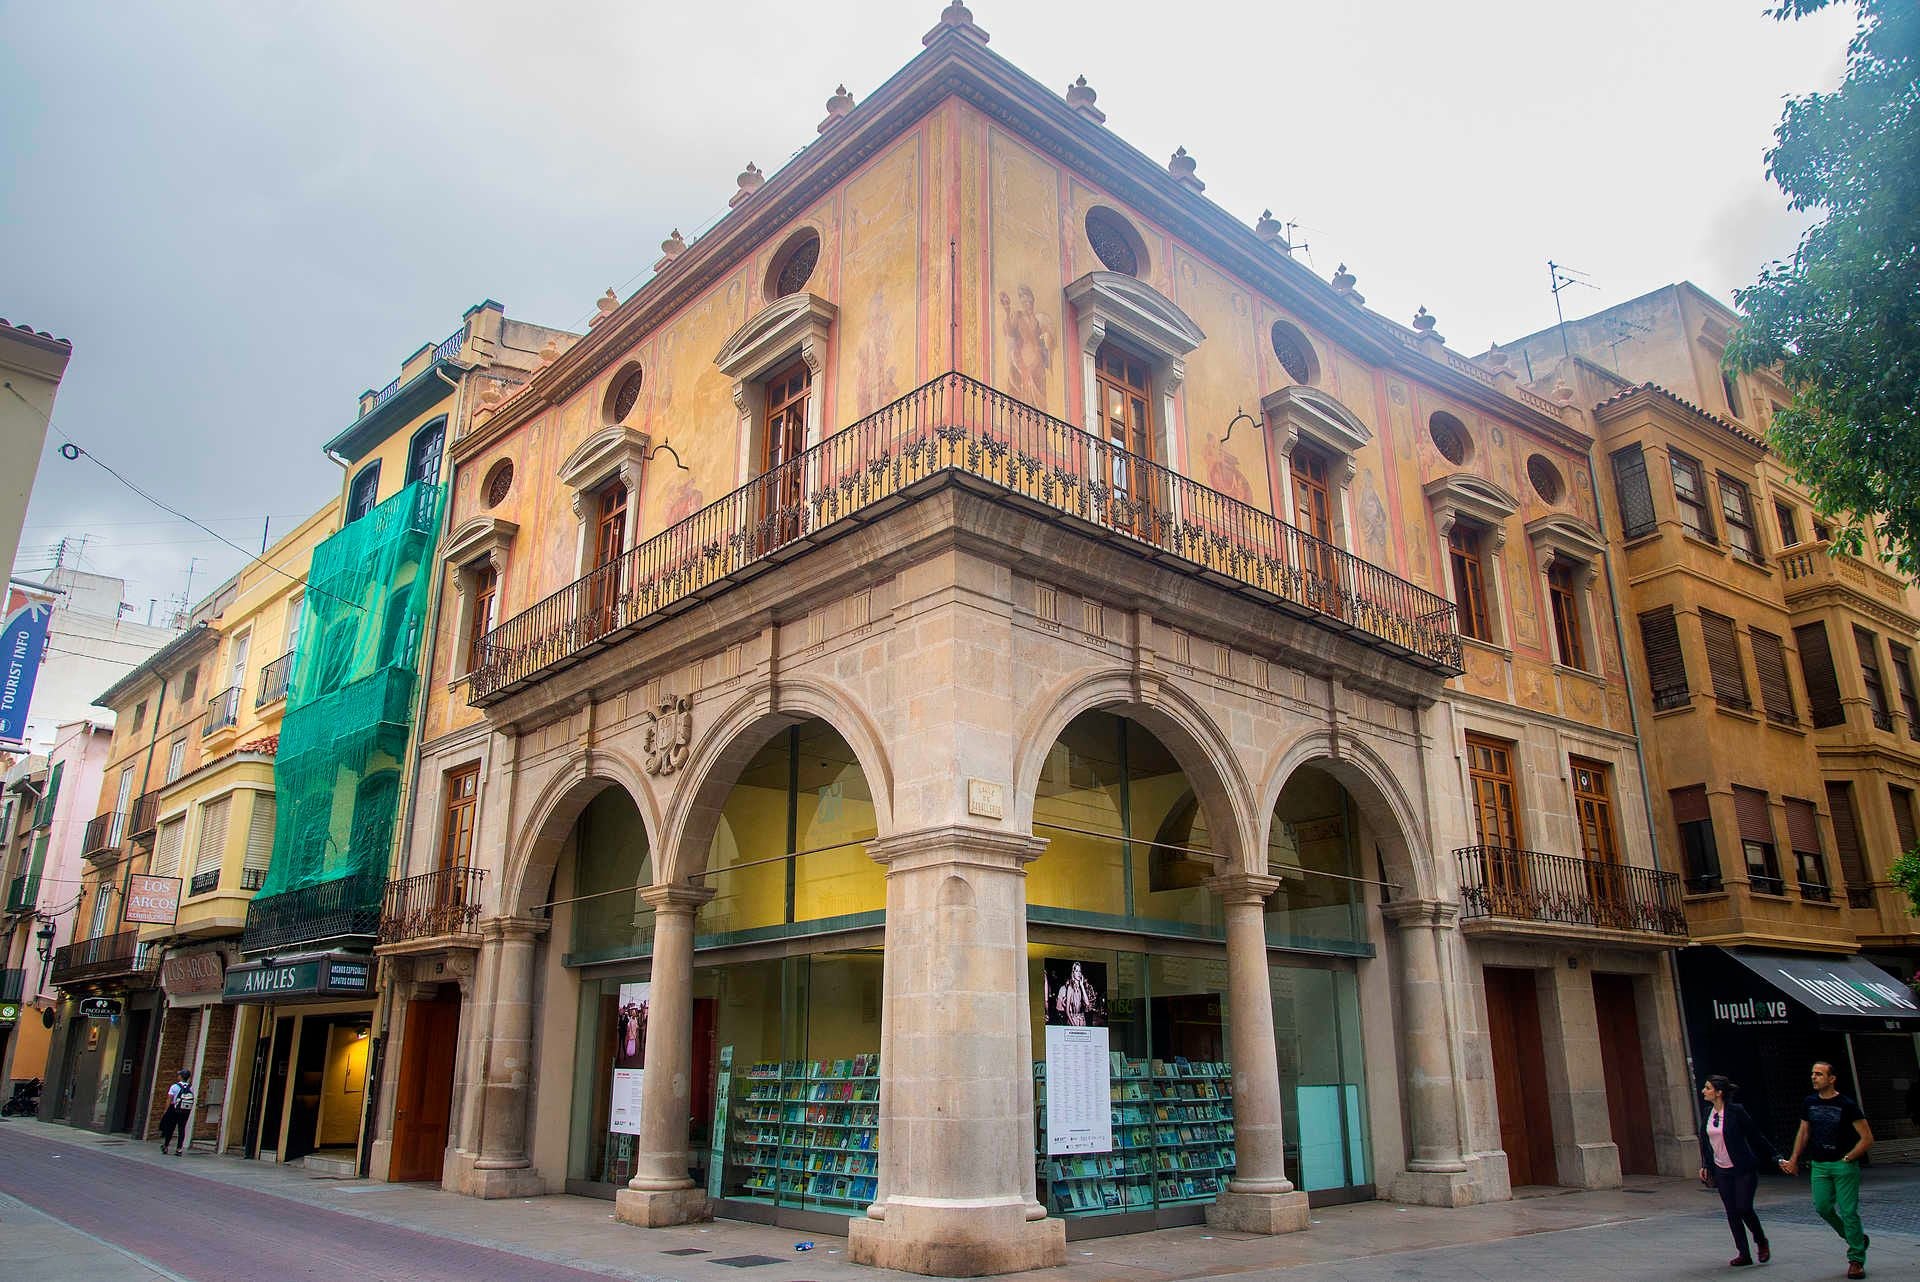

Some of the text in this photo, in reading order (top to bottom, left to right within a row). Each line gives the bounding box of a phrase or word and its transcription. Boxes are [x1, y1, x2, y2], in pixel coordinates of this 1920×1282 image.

[1, 631, 30, 710] TOURIST INFO
[144, 880, 169, 892] LOS
[131, 896, 177, 909] ARCOS
[185, 956, 218, 979] ARCOS
[244, 967, 296, 992] AMPLES
